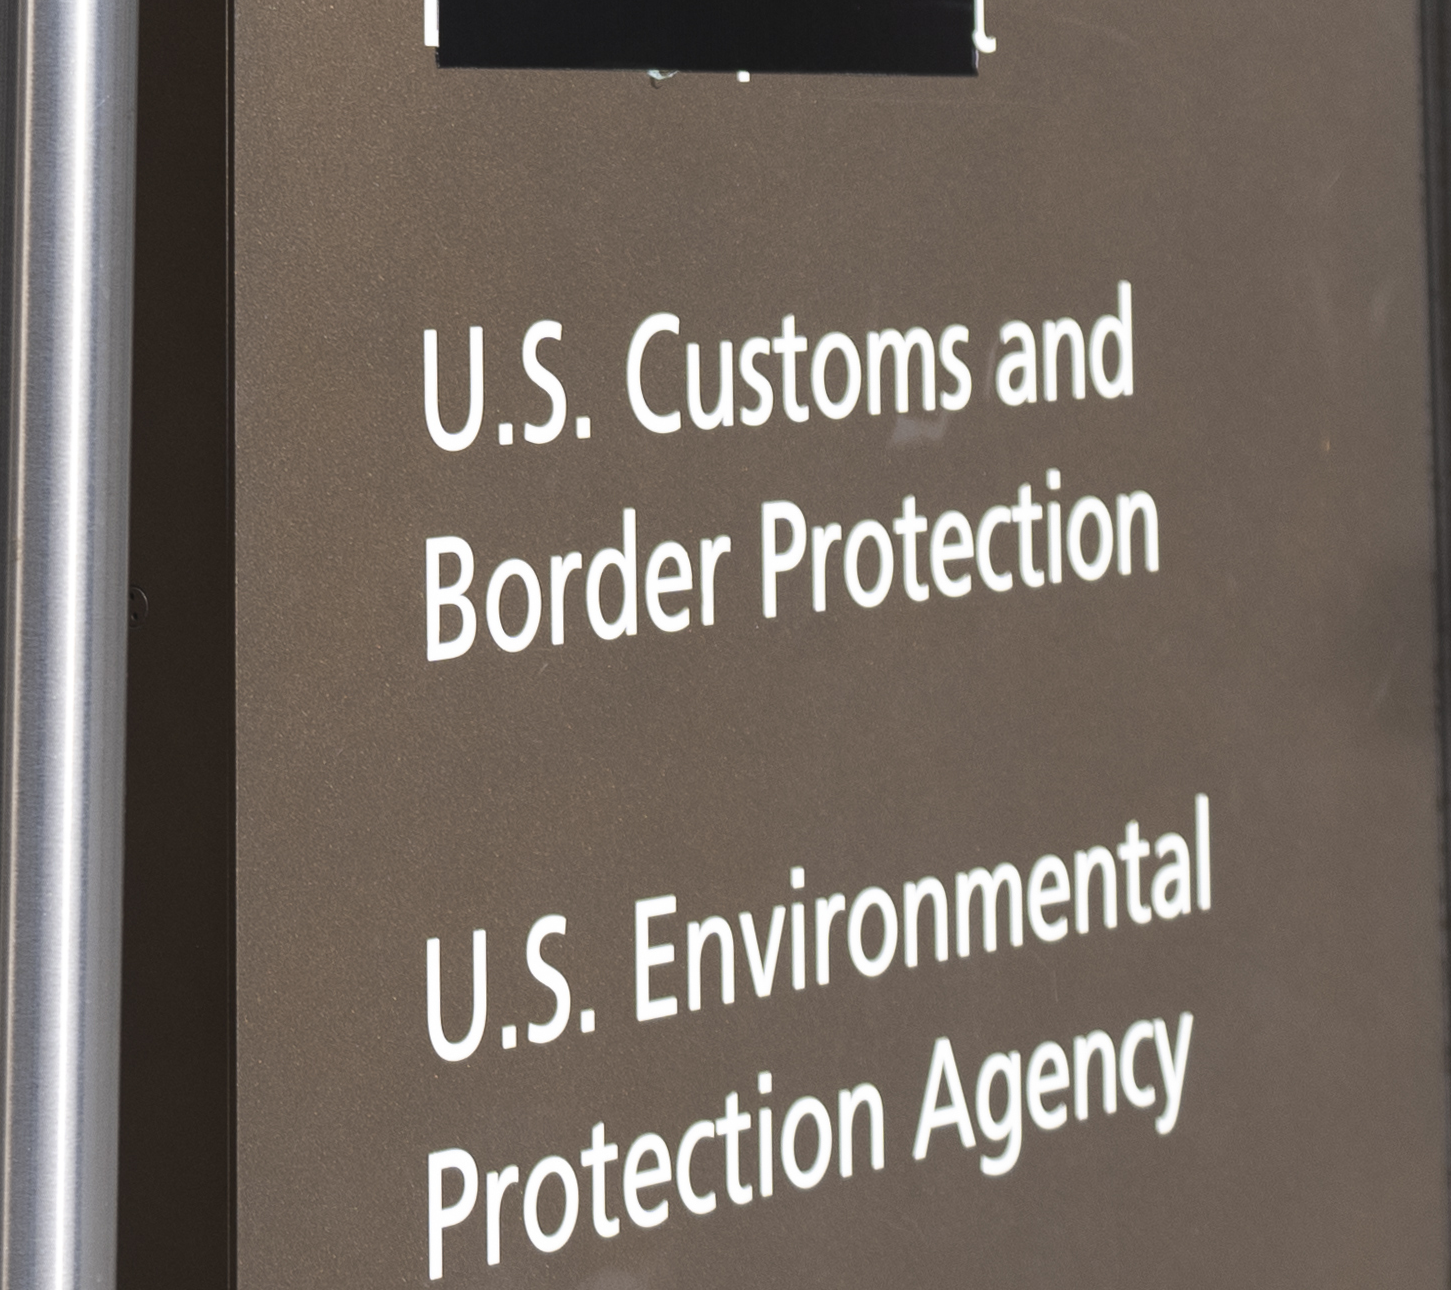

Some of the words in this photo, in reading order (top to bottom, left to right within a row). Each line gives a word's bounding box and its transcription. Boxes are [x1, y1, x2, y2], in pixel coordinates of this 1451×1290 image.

[423, 320, 591, 452] U.S.
[626, 311, 972, 434] Customs
[996, 280, 1134, 407] and
[426, 507, 731, 662] Border
[762, 469, 1159, 619] Protection
[426, 914, 596, 1062] U.S.
[635, 793, 1212, 1023] Environmental
[428, 1071, 885, 1281] Protection
[912, 1012, 1194, 1176] Agency
